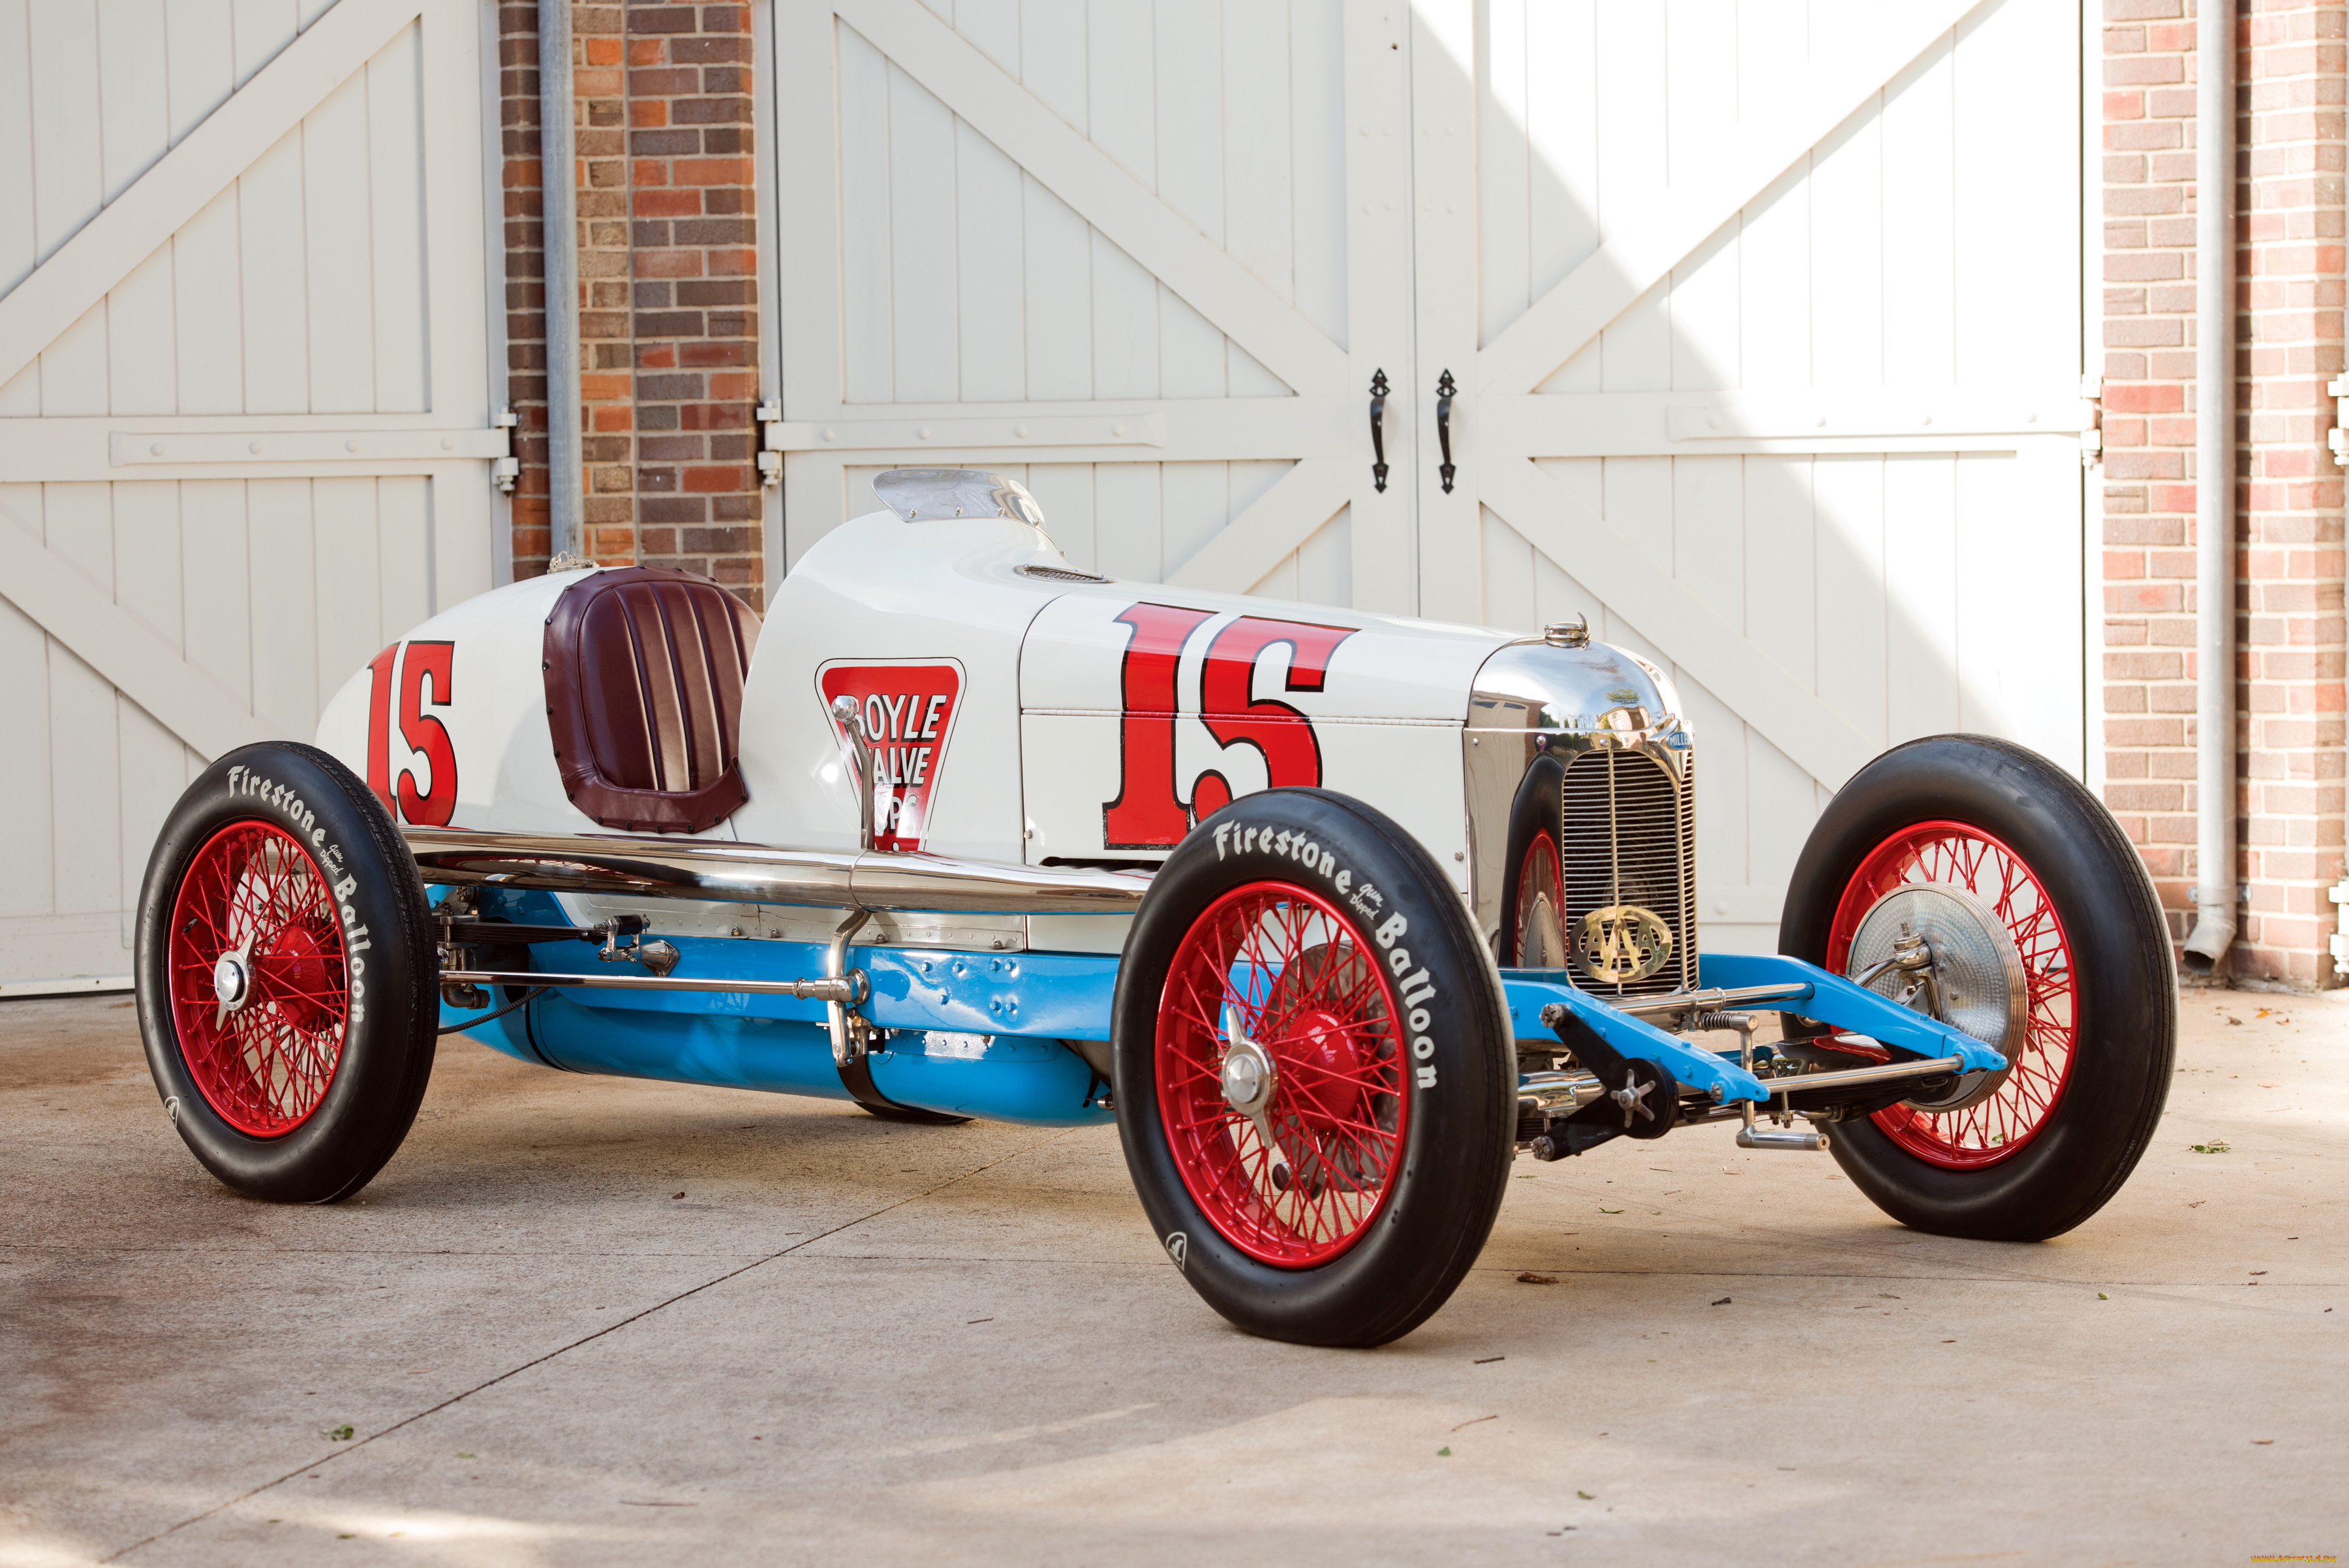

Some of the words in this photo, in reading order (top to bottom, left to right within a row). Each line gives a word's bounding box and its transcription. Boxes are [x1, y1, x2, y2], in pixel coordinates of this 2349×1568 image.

[366, 640, 458, 827] 15
[1102, 601, 1364, 851] 15
[1669, 732, 1690, 746] MILLE
[227, 765, 326, 848] Firestone
[1212, 820, 1351, 895] Firestone
[333, 873, 371, 1023] Balloon
[1375, 912, 1437, 1090] Balloon
